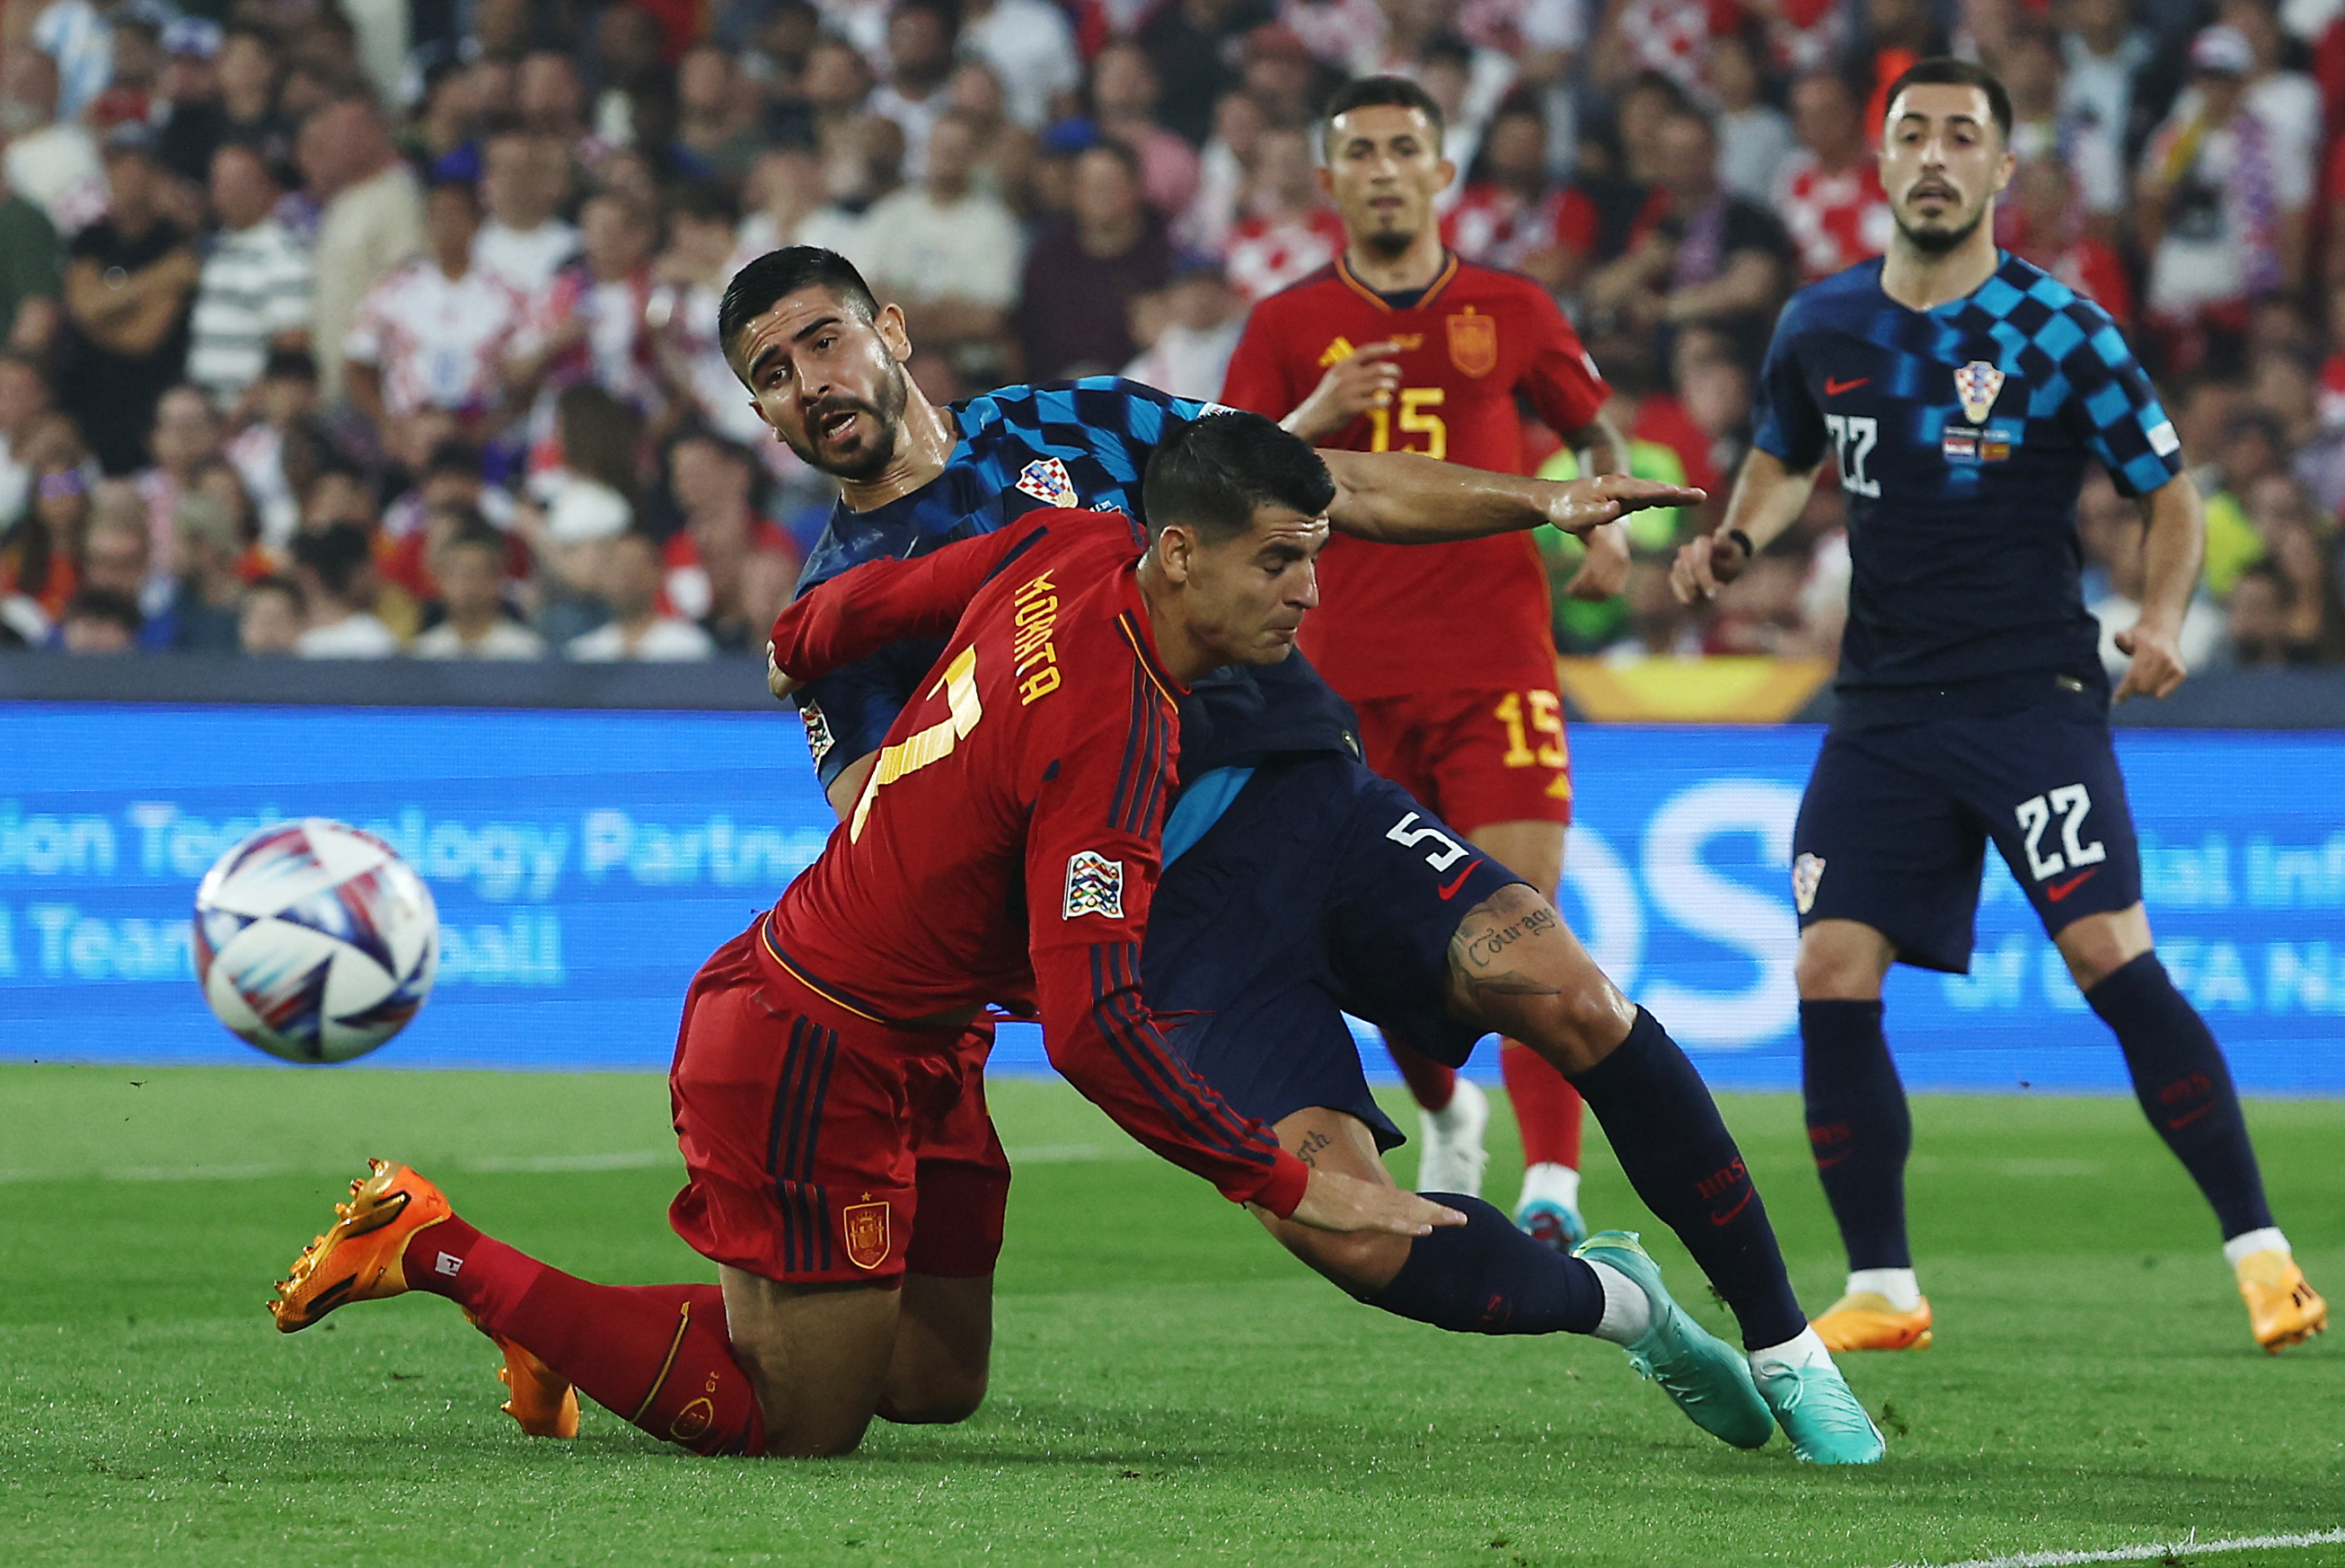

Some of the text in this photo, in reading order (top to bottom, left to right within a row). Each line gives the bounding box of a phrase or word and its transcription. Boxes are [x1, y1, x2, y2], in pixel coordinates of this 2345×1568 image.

[1366, 387, 1447, 460] 15
[1825, 412, 1882, 499] 22
[1014, 568, 1062, 707] MORATA
[850, 642, 983, 845] 7
[1493, 689, 1569, 769] 15
[1385, 810, 1469, 873] 5
[2014, 783, 2107, 882] 22
